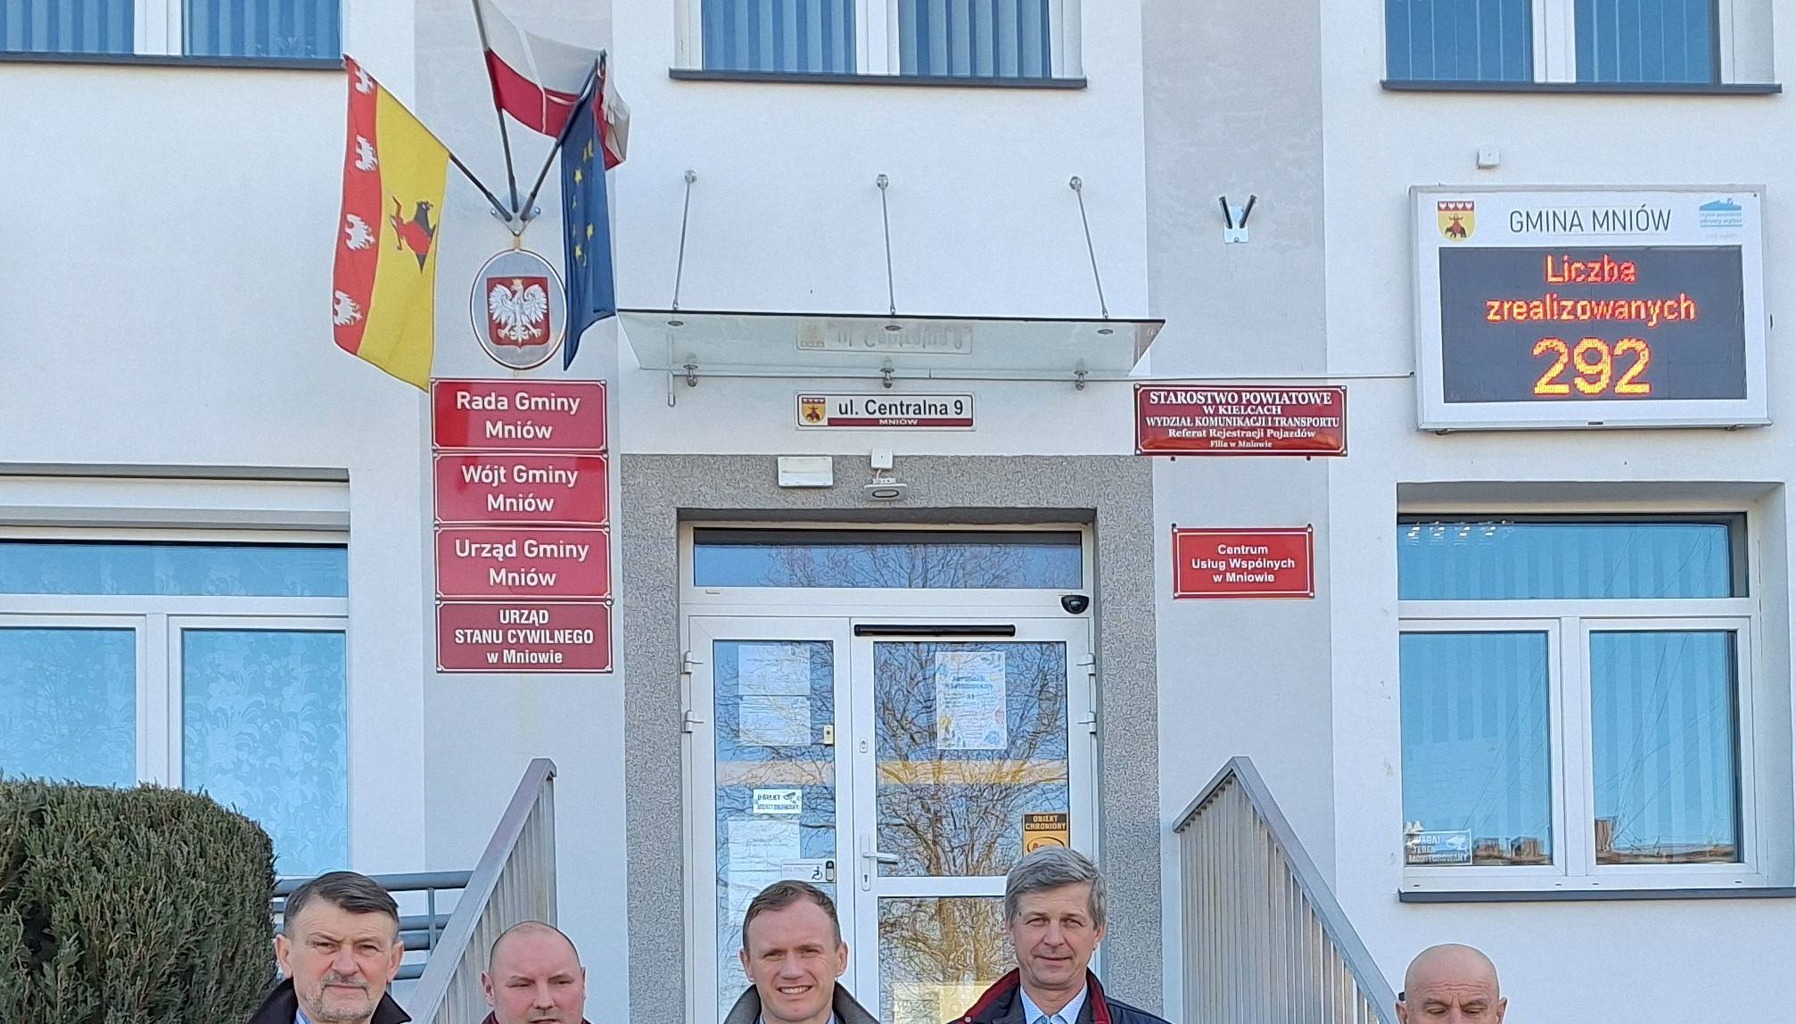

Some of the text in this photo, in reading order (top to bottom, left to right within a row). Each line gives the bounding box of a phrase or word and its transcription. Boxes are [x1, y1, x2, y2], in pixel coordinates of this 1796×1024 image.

[1510, 203, 1671, 233] GMINA MNIÓW
[1545, 254, 1637, 283] Liczba
[1486, 292, 1696, 327] zrealizowanych
[1532, 337, 1651, 395] 292
[457, 391, 580, 415] Rada Gminy
[1150, 391, 1332, 405] STAROSTWO POWIATOWE
[839, 399, 963, 415] ul. Centralna 9
[1203, 405, 1282, 415] W KIELCACH
[485, 421, 552, 439] Mniów
[1146, 416, 1194, 426] WYDZIAŁ
[1195, 417, 1265, 427] KOMUNIKACJI
[1273, 417, 1339, 427] TRANSPORTU
[1168, 429, 1315, 439] Referat Rejestracji Pojazdów
[1210, 440, 1228, 448] Filia
[1238, 440, 1273, 448] Mniowie
[461, 464, 579, 488] Wójt Gminy
[487, 493, 554, 512] Mniów
[455, 539, 589, 562] Urząd Gminy
[1217, 544, 1268, 555] Centrum
[1191, 558, 1296, 570] Usług Wspólnych
[489, 567, 556, 586] Mniów
[1212, 572, 1275, 583] w Mniowie
[500, 609, 549, 627] URZĄD
[455, 629, 594, 644] STANU CYWILNEGO
[487, 649, 563, 664] w Mniowie
